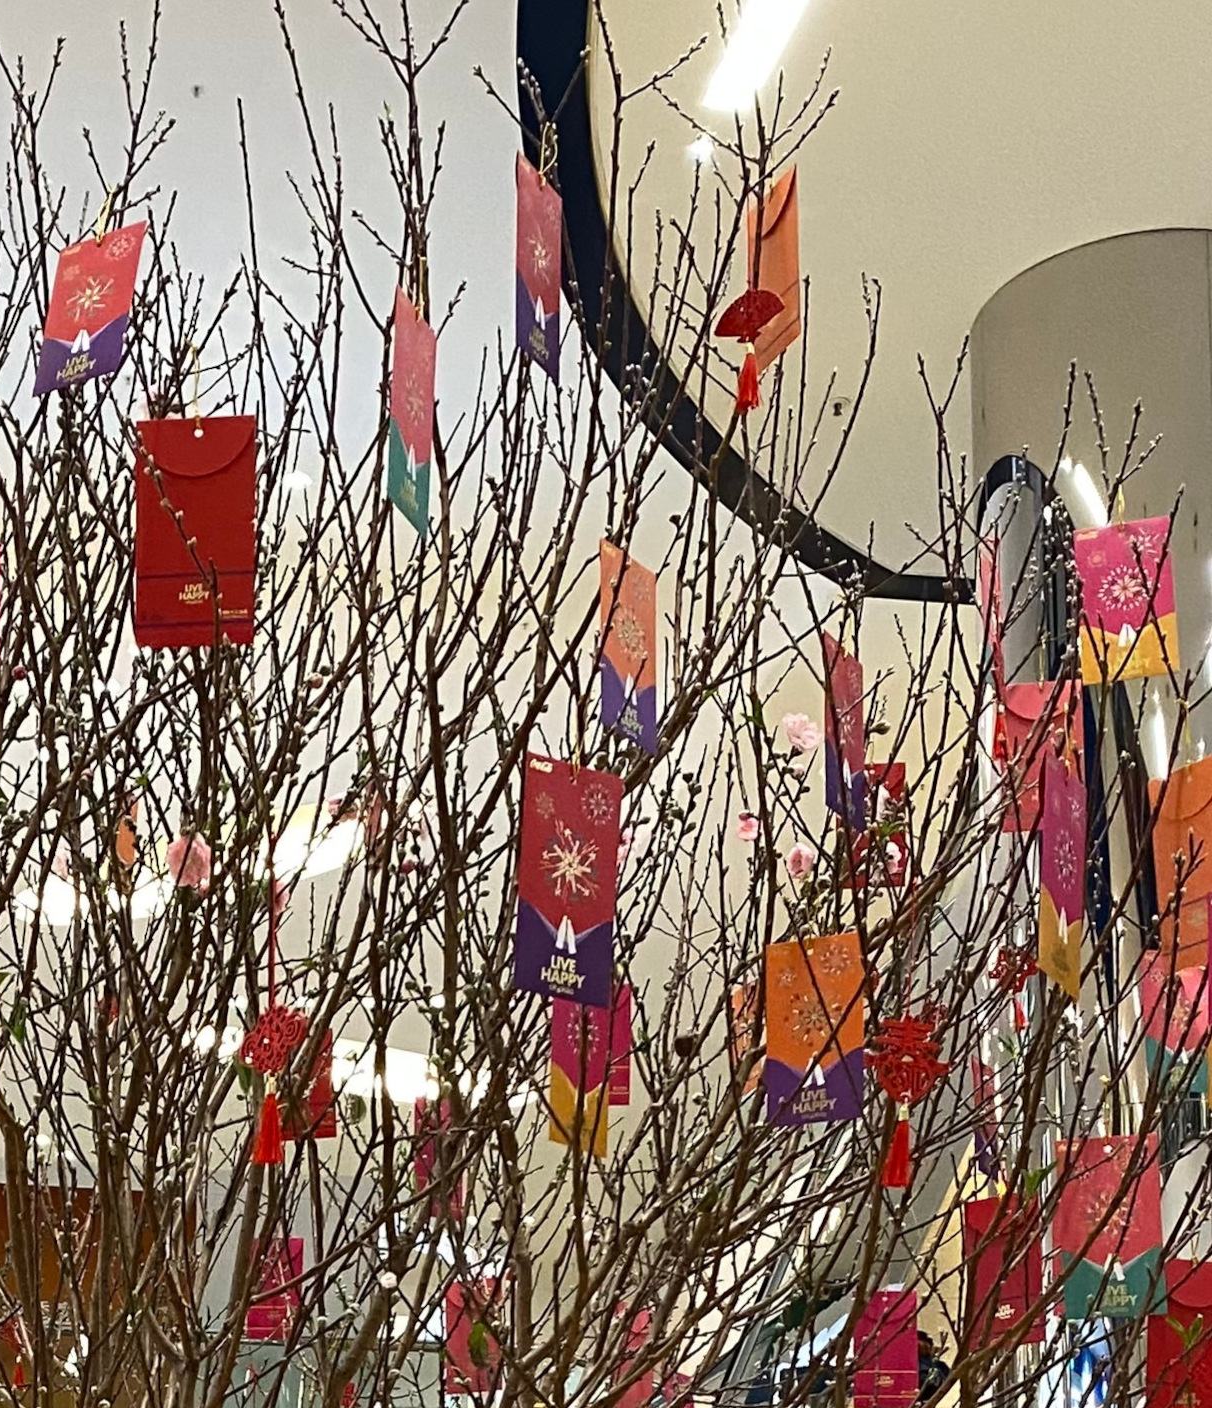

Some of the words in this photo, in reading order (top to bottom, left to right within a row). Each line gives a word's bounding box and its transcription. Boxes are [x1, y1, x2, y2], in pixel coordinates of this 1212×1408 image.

[56, 359, 97, 380] HAPPY
[550, 954, 576, 973] LIVE
[540, 966, 586, 989] HAPPY
[801, 1088, 827, 1102] LIVE
[792, 1097, 837, 1114] HAPPY
